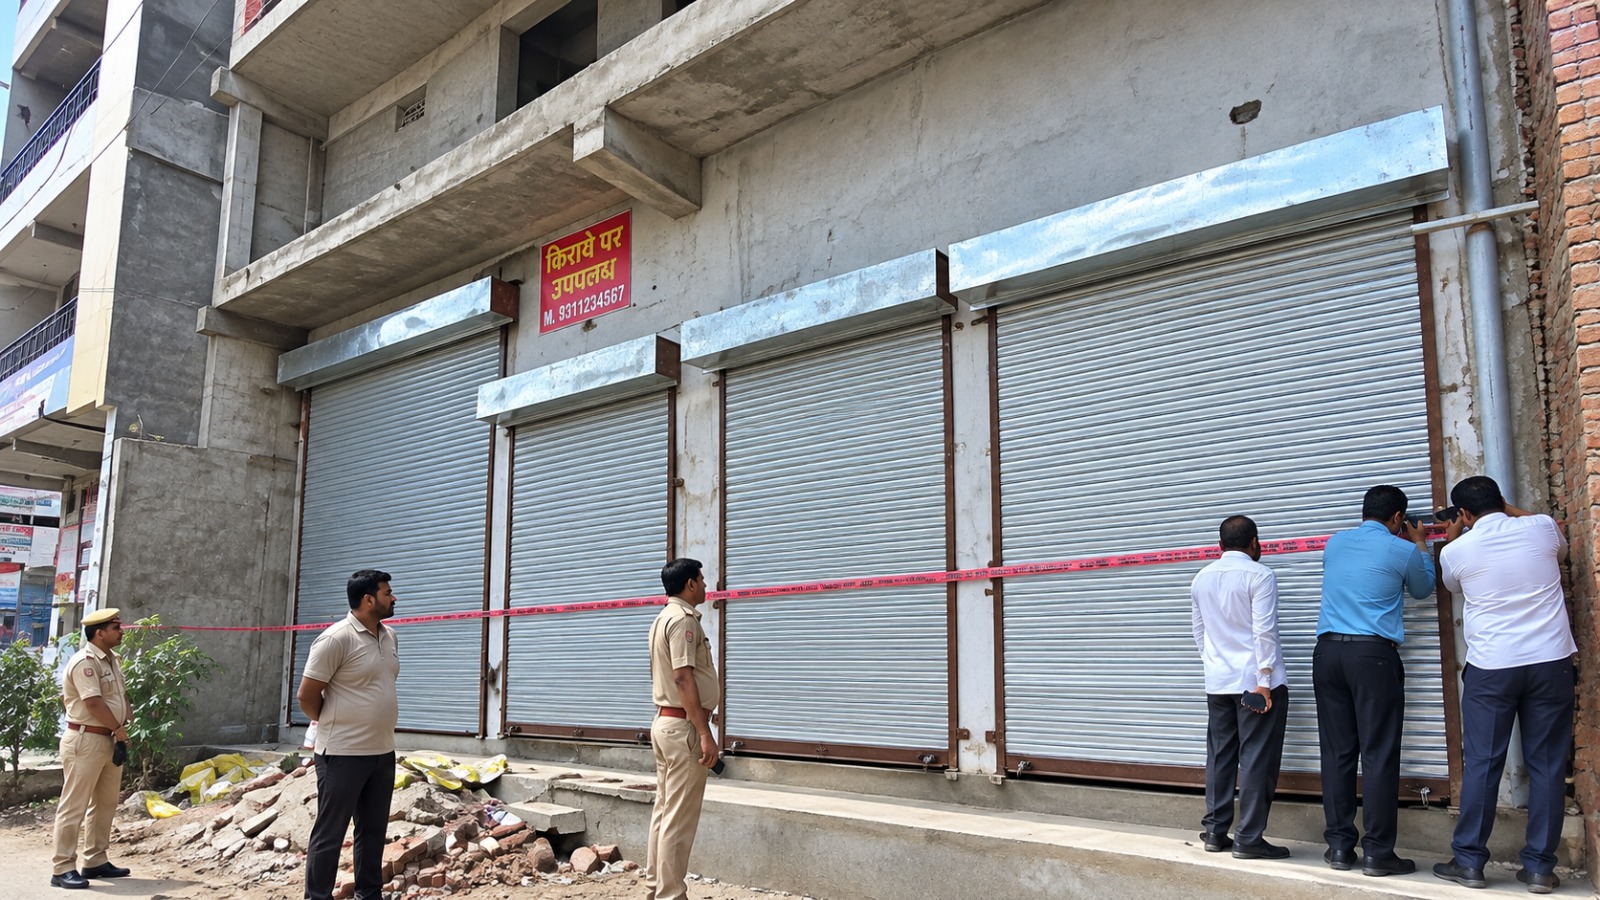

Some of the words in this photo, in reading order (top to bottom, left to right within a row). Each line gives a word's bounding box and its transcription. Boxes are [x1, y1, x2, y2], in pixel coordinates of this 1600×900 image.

[599, 225, 624, 252] पर
[543, 311, 555, 327] M.
[559, 284, 625, 322] 9311234567
